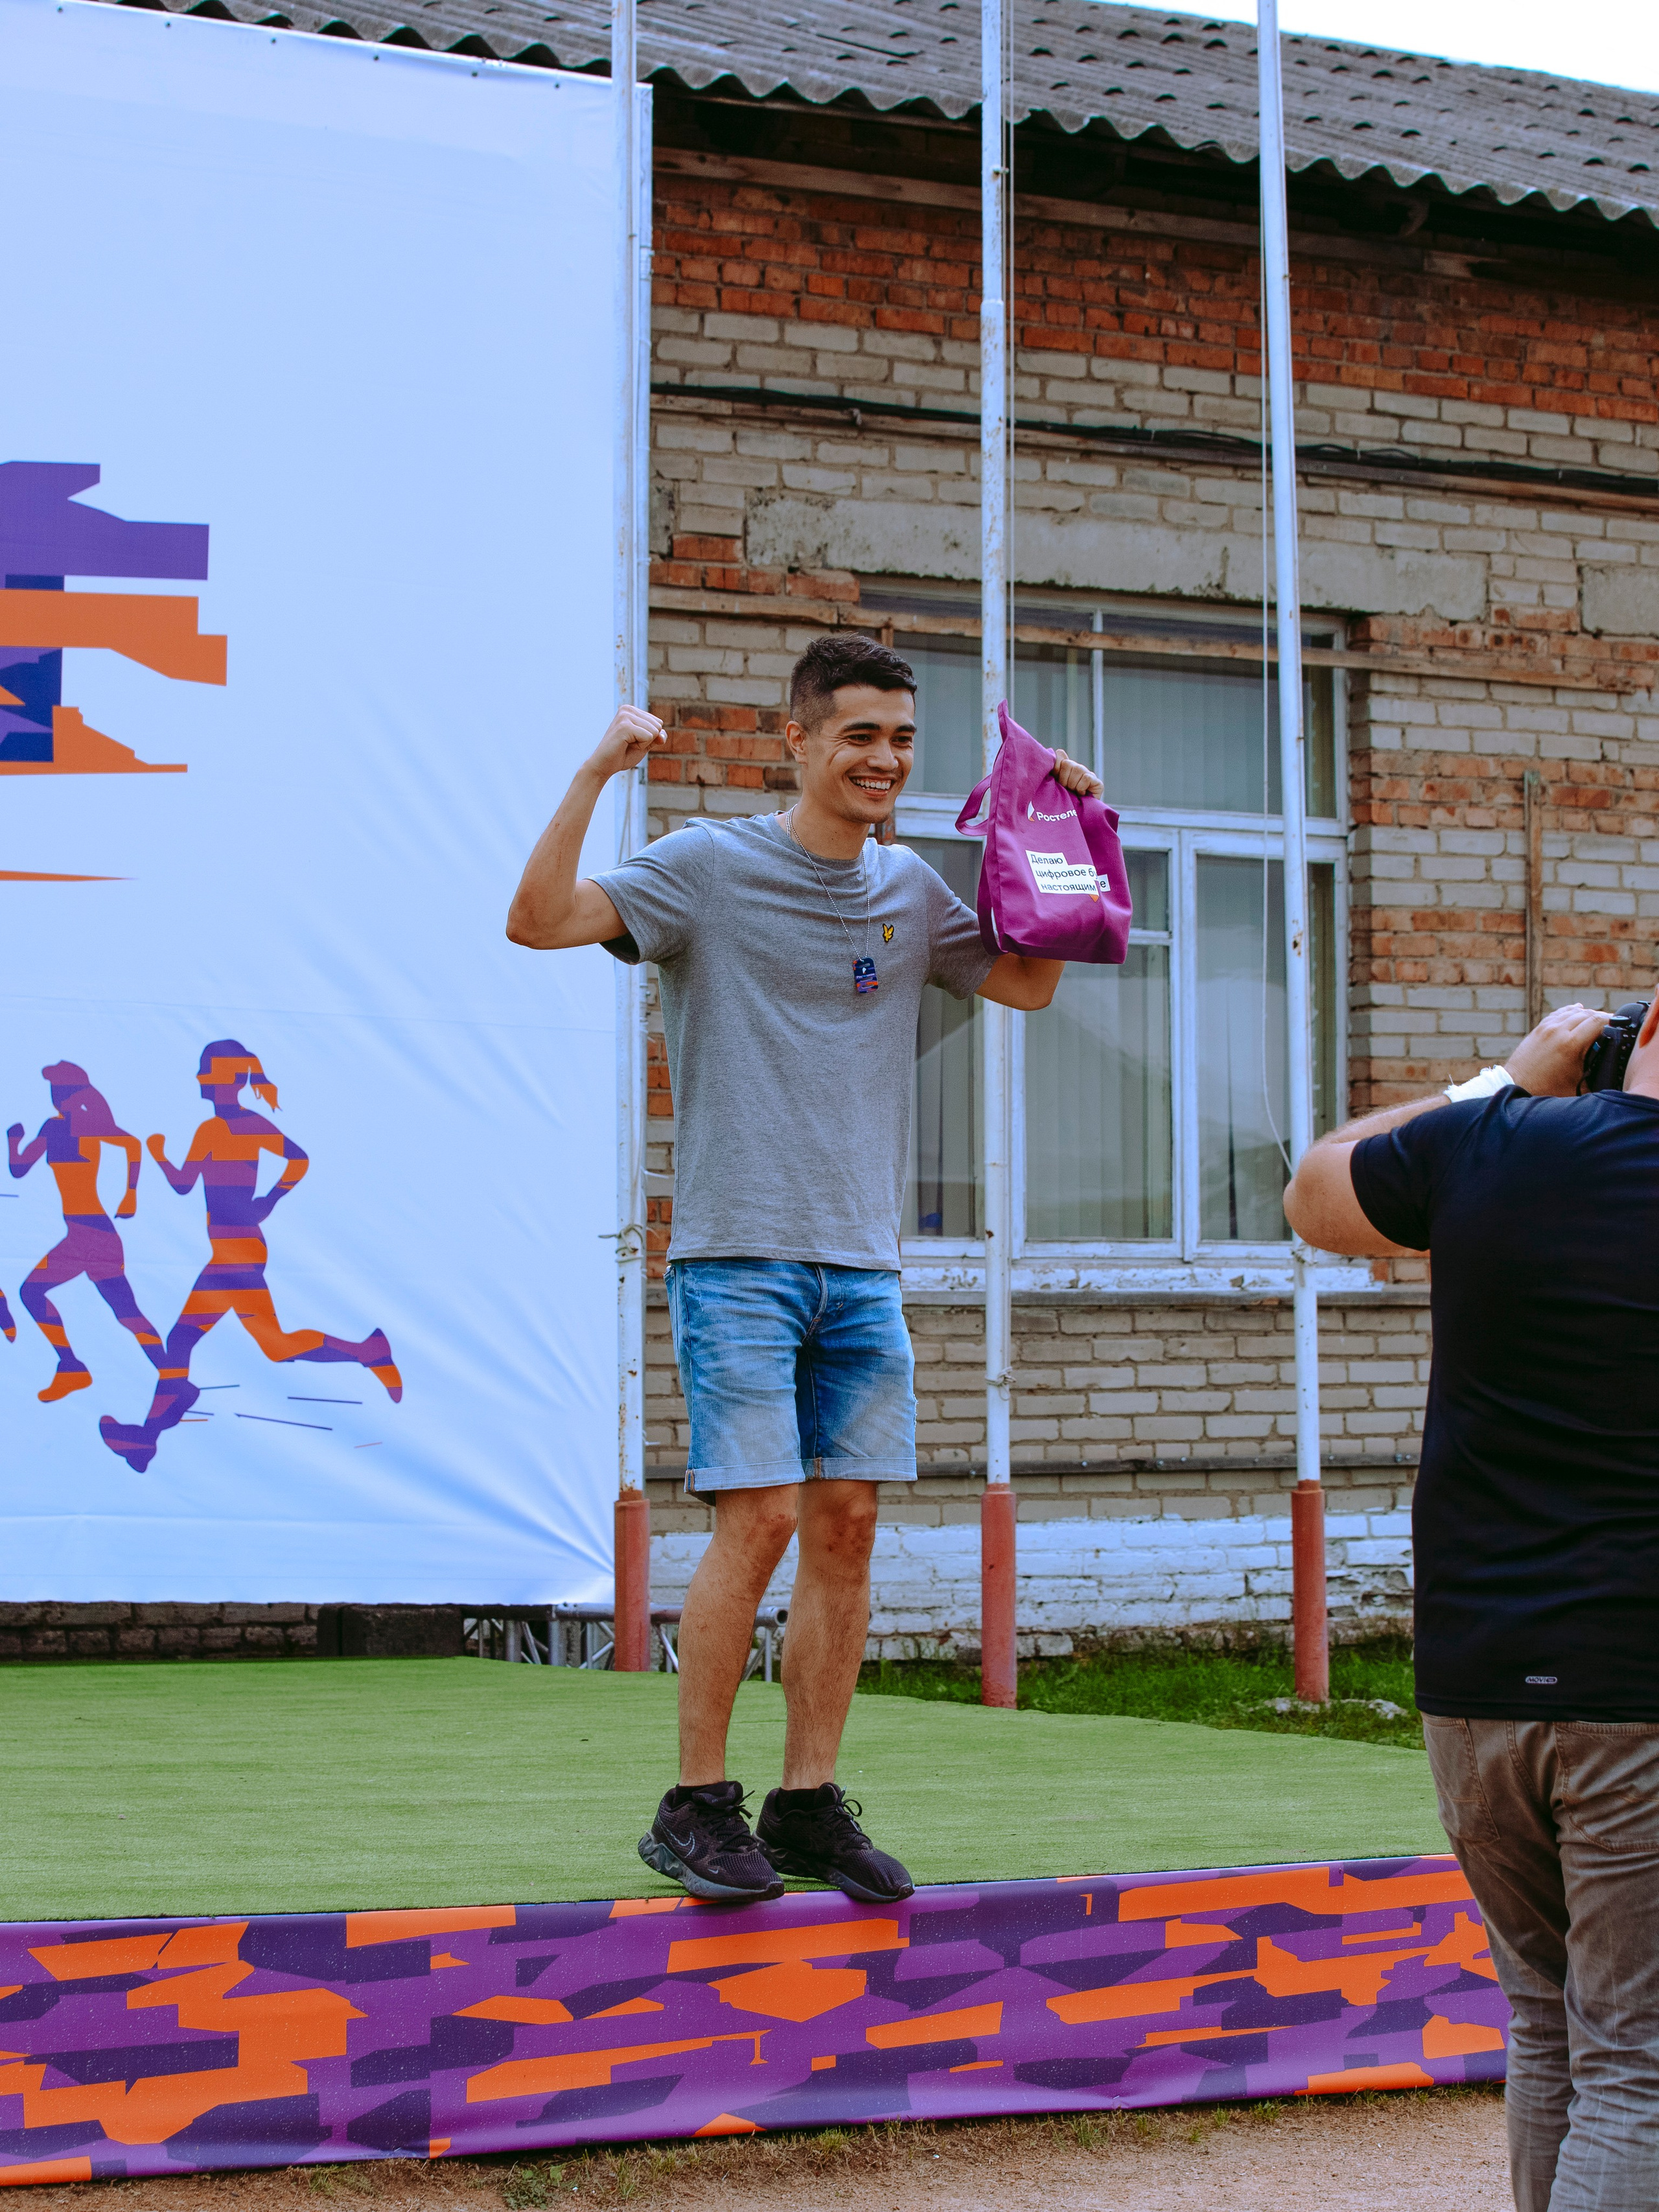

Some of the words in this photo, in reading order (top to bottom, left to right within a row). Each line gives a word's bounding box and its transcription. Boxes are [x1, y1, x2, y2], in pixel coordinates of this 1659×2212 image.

[1030, 854, 1063, 865] Делаю
[1035, 869, 1087, 880] цифровое
[1040, 883, 1096, 892] настоящим
